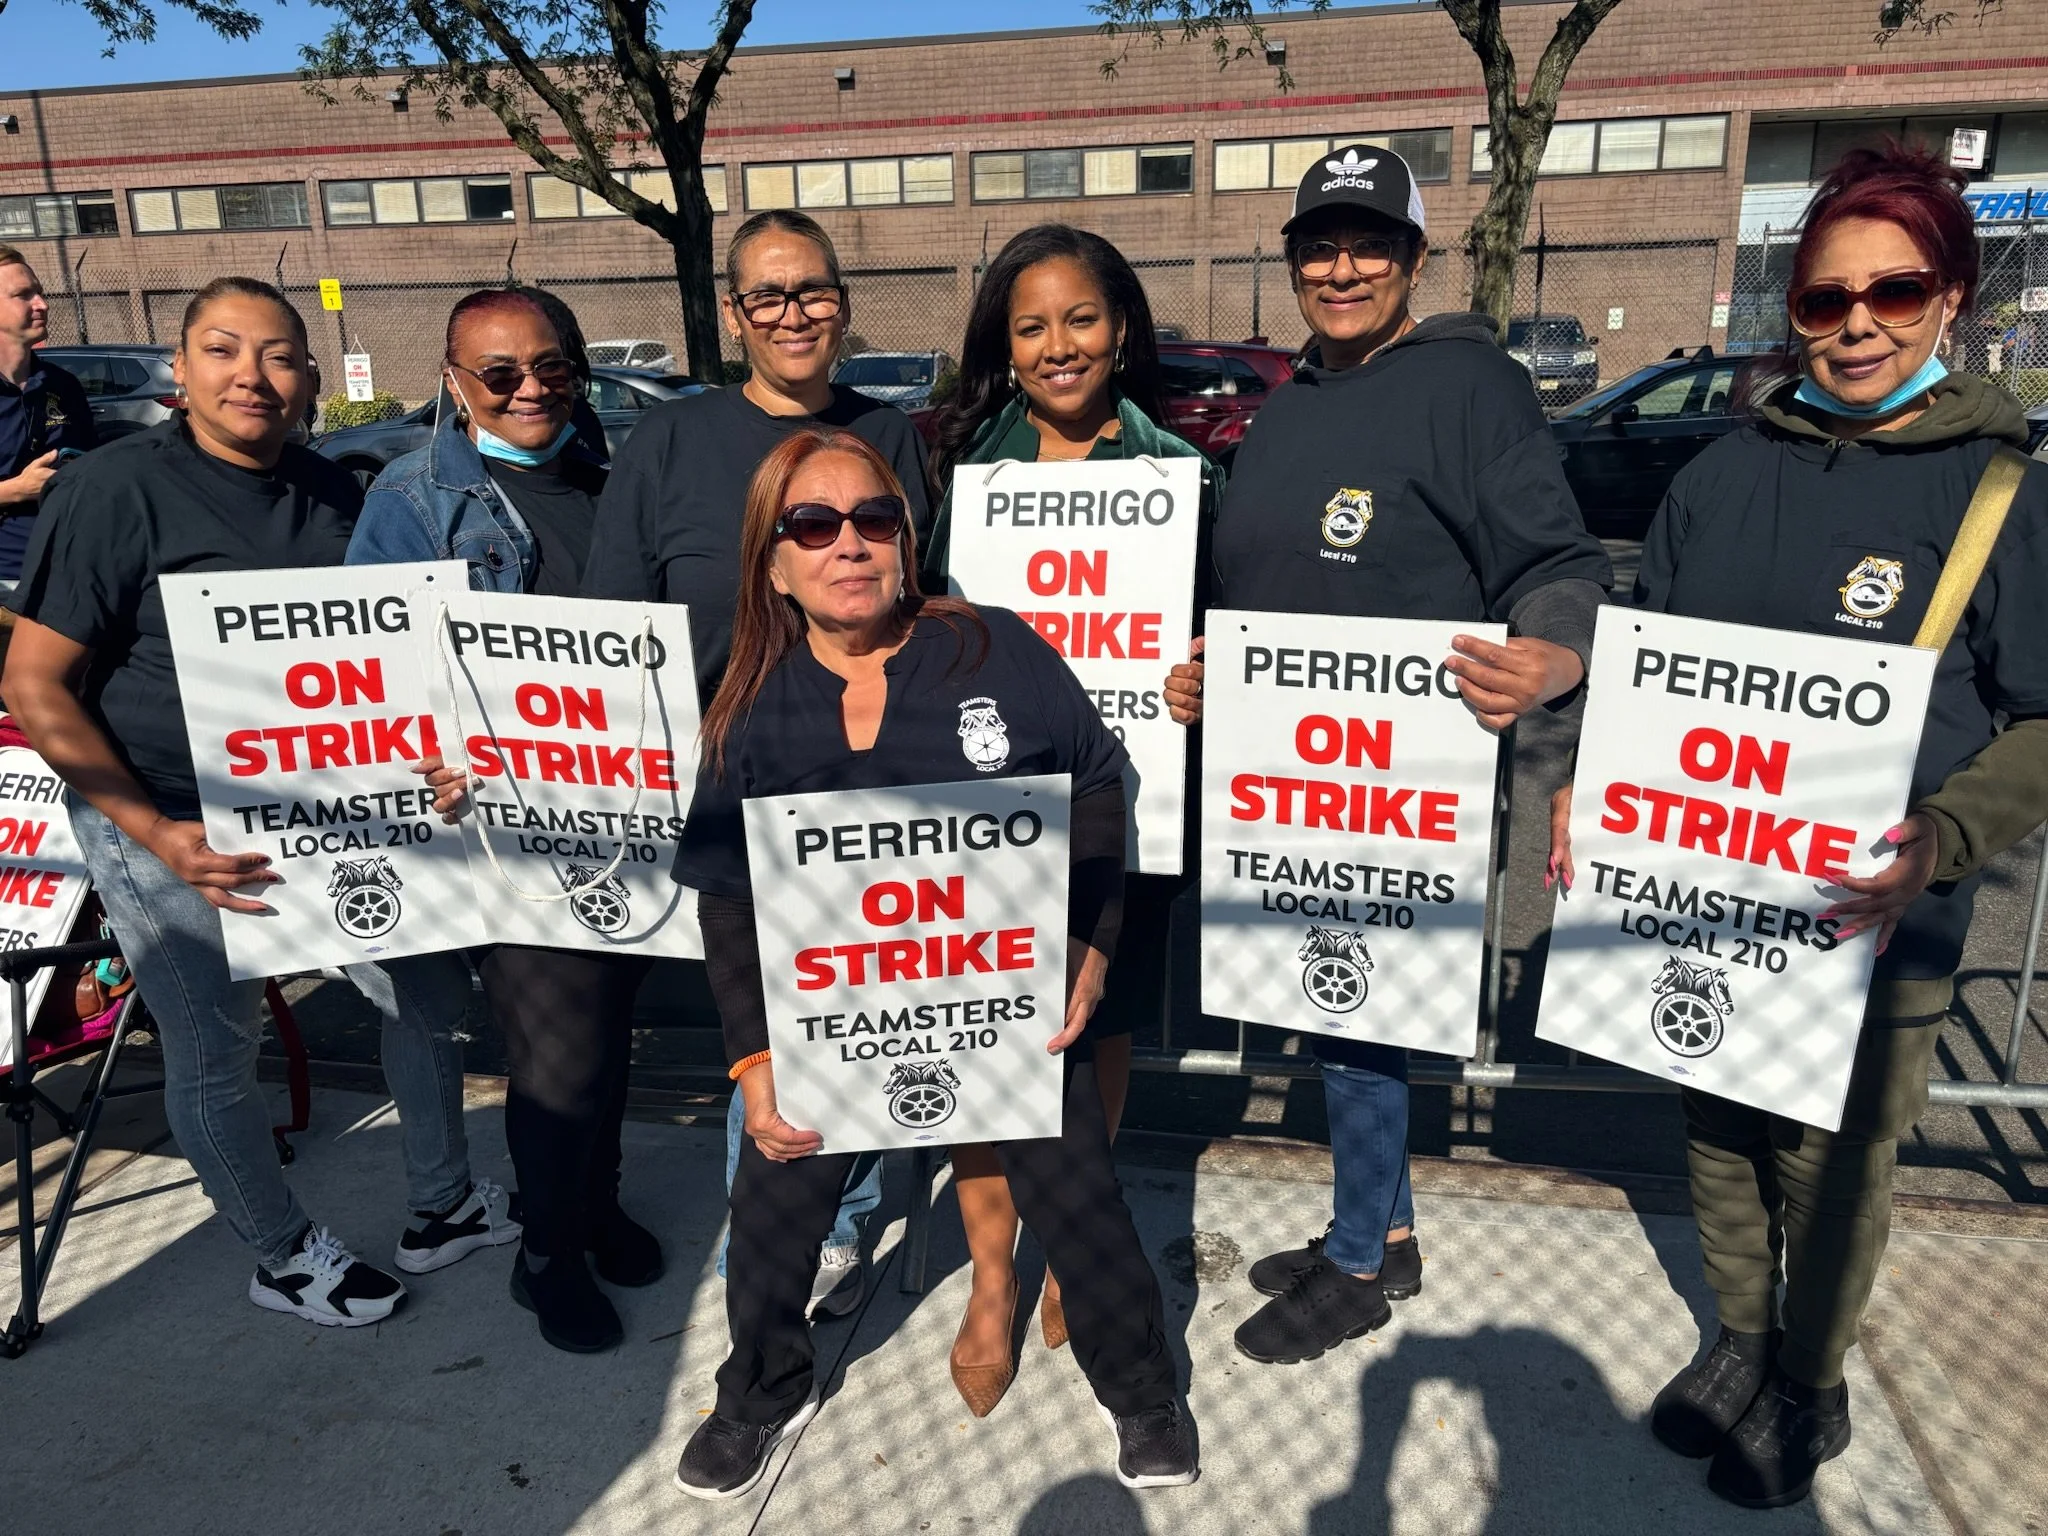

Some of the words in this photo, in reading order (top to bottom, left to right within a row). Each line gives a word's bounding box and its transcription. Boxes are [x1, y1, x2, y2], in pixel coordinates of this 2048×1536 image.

[1321, 176, 1374, 192] adidas
[985, 489, 1175, 527] PERRIGO
[1027, 550, 1108, 596] ON
[1320, 548, 1341, 560] Local
[1341, 552, 1357, 564] 210
[214, 595, 411, 645] PERRIG
[449, 619, 668, 671] PERRIGO
[1834, 612, 1865, 627] LOCAL
[1865, 619, 1884, 630] 210
[285, 657, 386, 710] ON
[515, 682, 608, 732] ON
[958, 696, 998, 710] TEAMSTERS
[1632, 647, 1891, 727] PERRIGO
[466, 734, 680, 791] STRIKE
[1295, 714, 1393, 770] ON
[1680, 727, 1790, 796] ON
[976, 764, 998, 772] LOCAL
[233, 787, 436, 835] TEAMSTER
[476, 801, 685, 842] TEAMSTERS
[1231, 773, 1459, 842] STRIKE
[280, 828, 380, 859] LOCAL
[384, 821, 433, 848] 210
[518, 834, 609, 861] LOCAL
[796, 809, 1043, 866] PERRIGO
[1601, 782, 1858, 884] STRIKE
[862, 875, 965, 927] ON
[1226, 849, 1455, 905] TEAMSTERS
[1262, 890, 1358, 924] LOCAL
[1364, 901, 1415, 930] 210
[1590, 861, 1841, 953] TEAMSTERS
[795, 927, 1035, 991] STRIKE
[1620, 908, 1722, 959] LOCAL
[1730, 937, 1788, 975] 210
[797, 995, 1036, 1042] TEAMSTERS
[840, 1035, 942, 1062] LOCAL
[949, 1027, 998, 1052] 210
